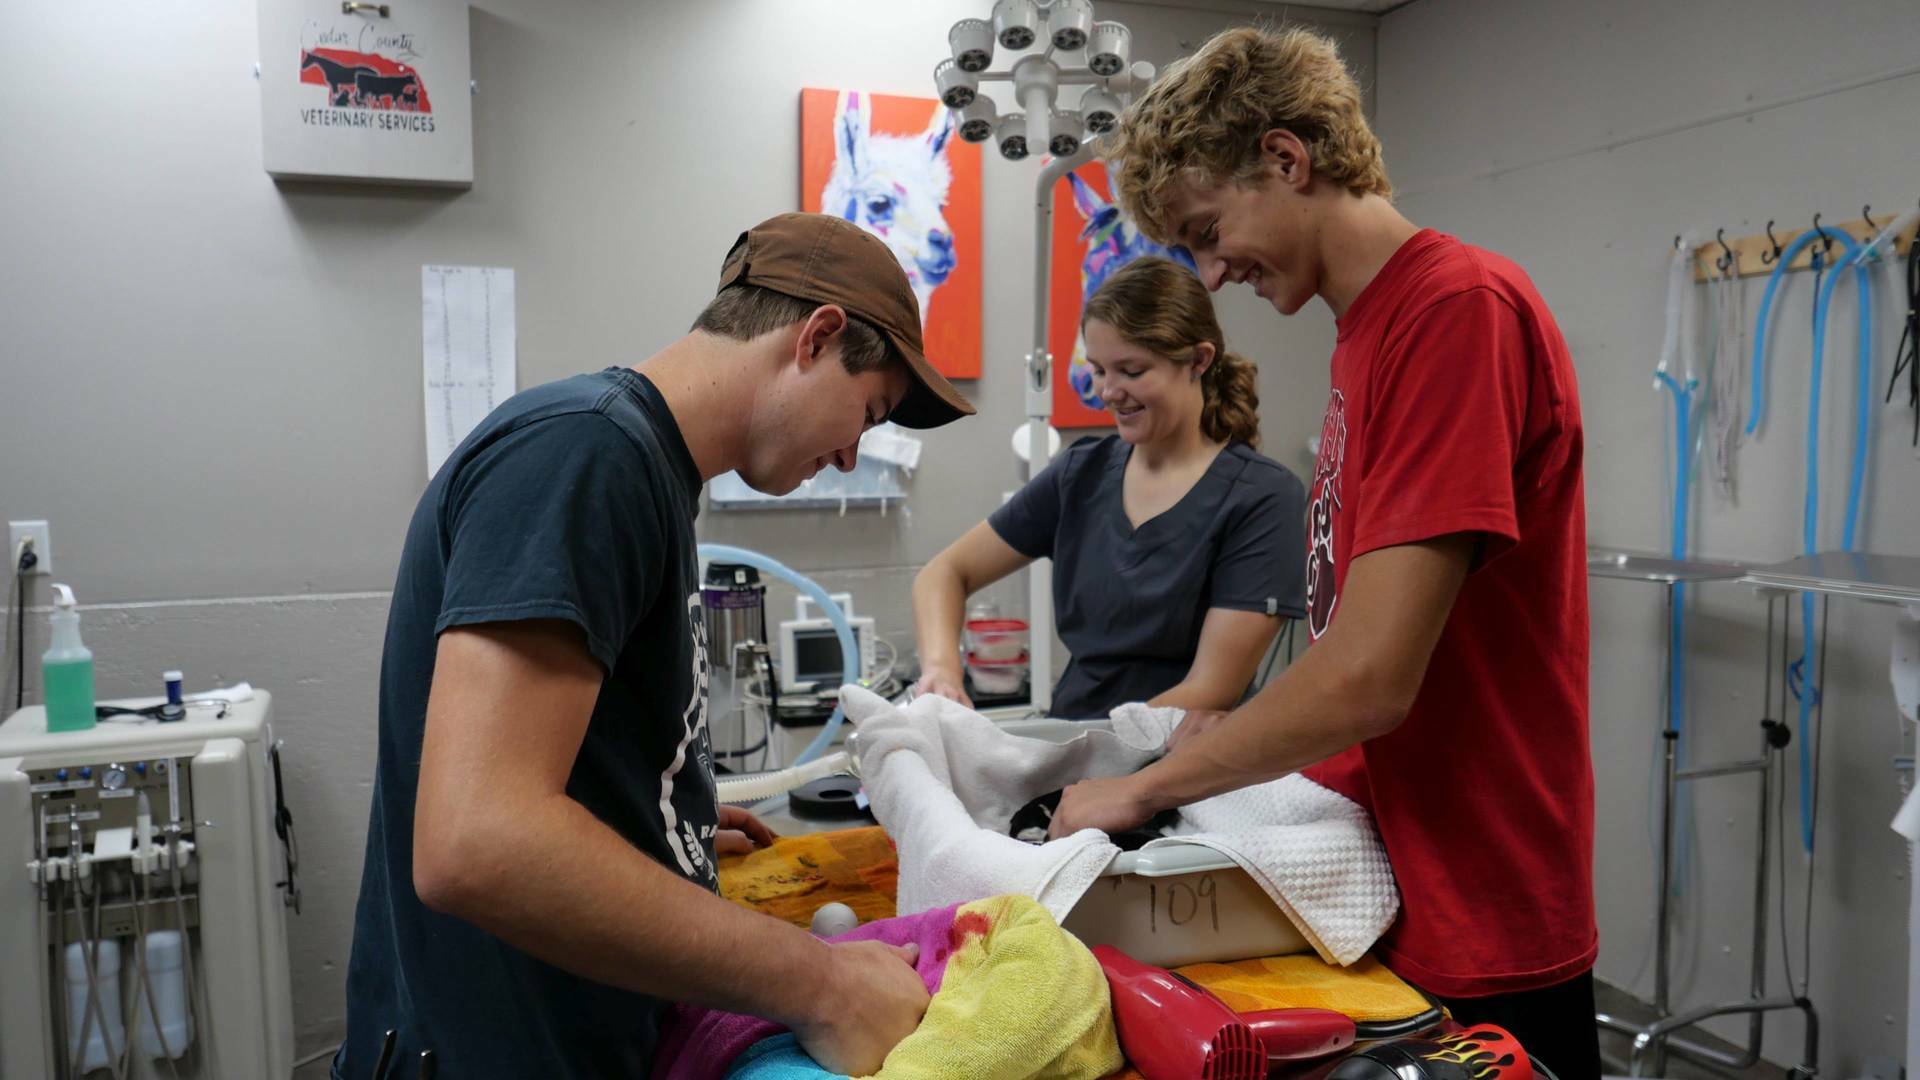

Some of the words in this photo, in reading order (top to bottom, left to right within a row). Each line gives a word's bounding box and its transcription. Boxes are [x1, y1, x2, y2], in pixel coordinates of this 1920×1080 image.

[358, 22, 424, 61] County
[300, 108, 374, 129] VETERINARY
[378, 113, 436, 132] SERVICES
[1149, 873, 1219, 933] 109
